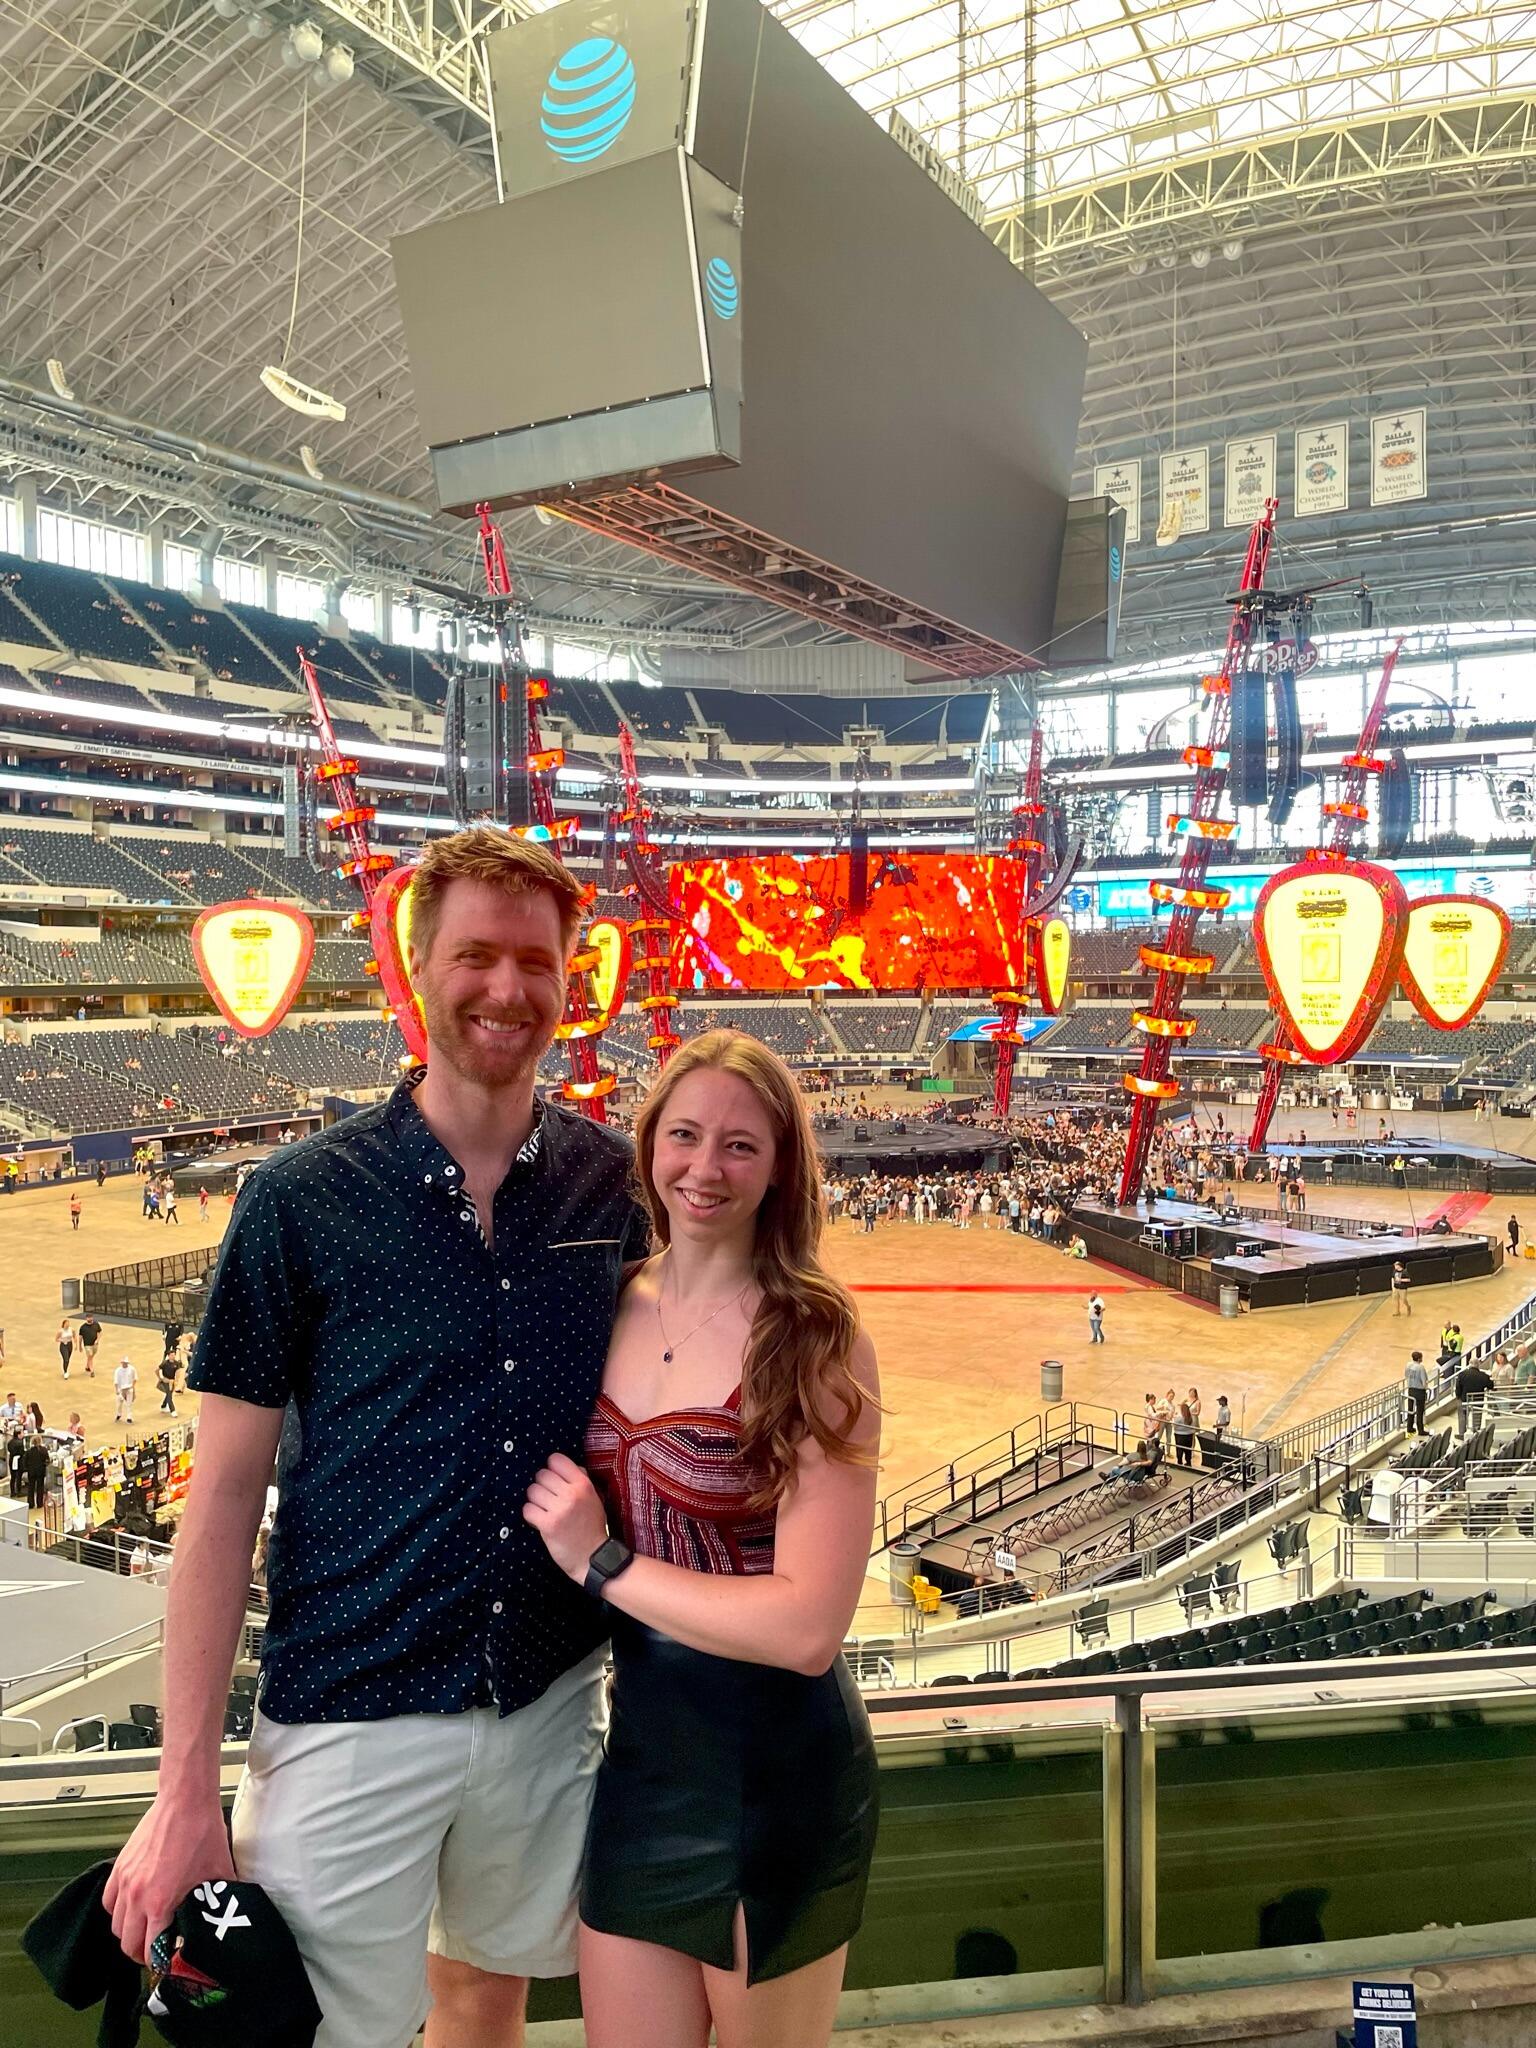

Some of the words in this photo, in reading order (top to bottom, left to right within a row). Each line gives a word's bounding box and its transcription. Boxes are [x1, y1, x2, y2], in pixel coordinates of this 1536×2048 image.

[927, 148, 986, 231] STADIUM
[1384, 431, 1412, 442] DALLAS
[1381, 437, 1415, 449] COWBOYS
[1308, 444, 1335, 454] DALLAS
[1238, 456, 1263, 466] DALLAS
[1305, 450, 1337, 461] COWBOYS
[1172, 467, 1196, 477] DALLAS
[1235, 462, 1266, 473] COWBOYS
[1169, 474, 1199, 485] COWBOYS
[1385, 473, 1413, 482] WORLD
[1105, 479, 1129, 489] DALLAS
[1375, 480, 1421, 494] CHAMPIONS
[1308, 485, 1335, 495] WORLD
[1237, 497, 1263, 506] WORLD
[1299, 491, 1343, 504] CHAMPIONS
[83, 745, 108, 754] EMMITT
[110, 748, 131, 756] SMITH
[209, 761, 229, 770] LARRY
[230, 763, 250, 771] ALLEN
[1361, 1987, 1372, 1997] GET
[1373, 1988, 1390, 1998] YOUR
[1390, 1989, 1404, 1999] FOOD
